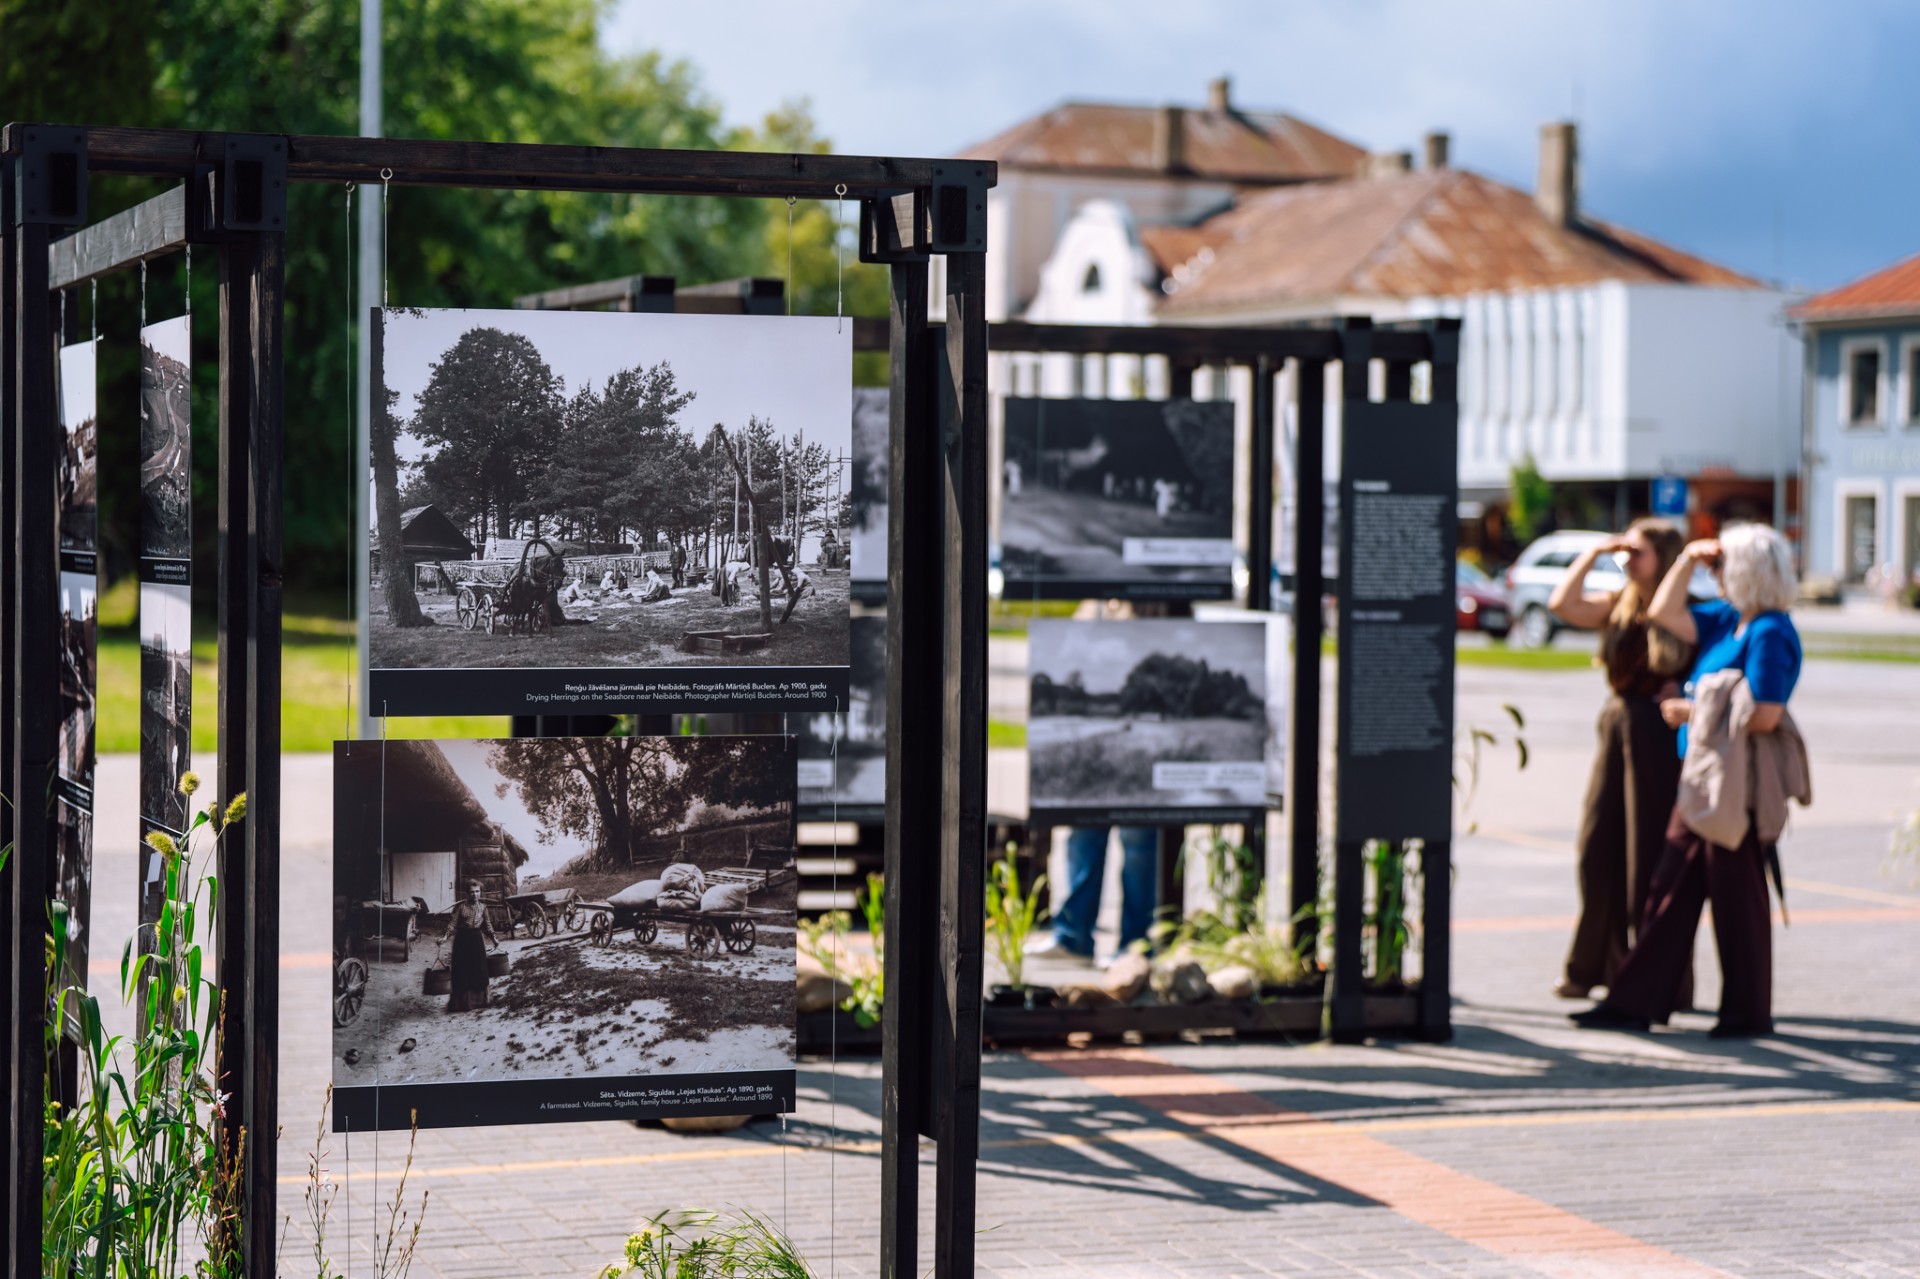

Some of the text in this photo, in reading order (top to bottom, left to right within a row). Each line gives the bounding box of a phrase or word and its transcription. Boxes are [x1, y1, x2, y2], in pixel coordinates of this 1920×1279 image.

[693, 683, 724, 691] Fotogrāfs
[726, 683, 750, 691] Mārtiņš
[779, 683, 789, 691] Ap
[810, 682, 827, 691] gadu
[526, 694, 549, 702] Drying
[550, 693, 579, 702] Herrings
[684, 692, 729, 701] Photographer
[617, 1090, 647, 1098] Vidzeme,
[648, 1088, 675, 1097] Siguldas
[727, 1086, 737, 1094] Ap
[756, 1084, 773, 1094] gadu
[583, 1101, 612, 1109] Vidzeme,
[614, 1099, 639, 1108] Sigulda,
[641, 1098, 660, 1106] family
